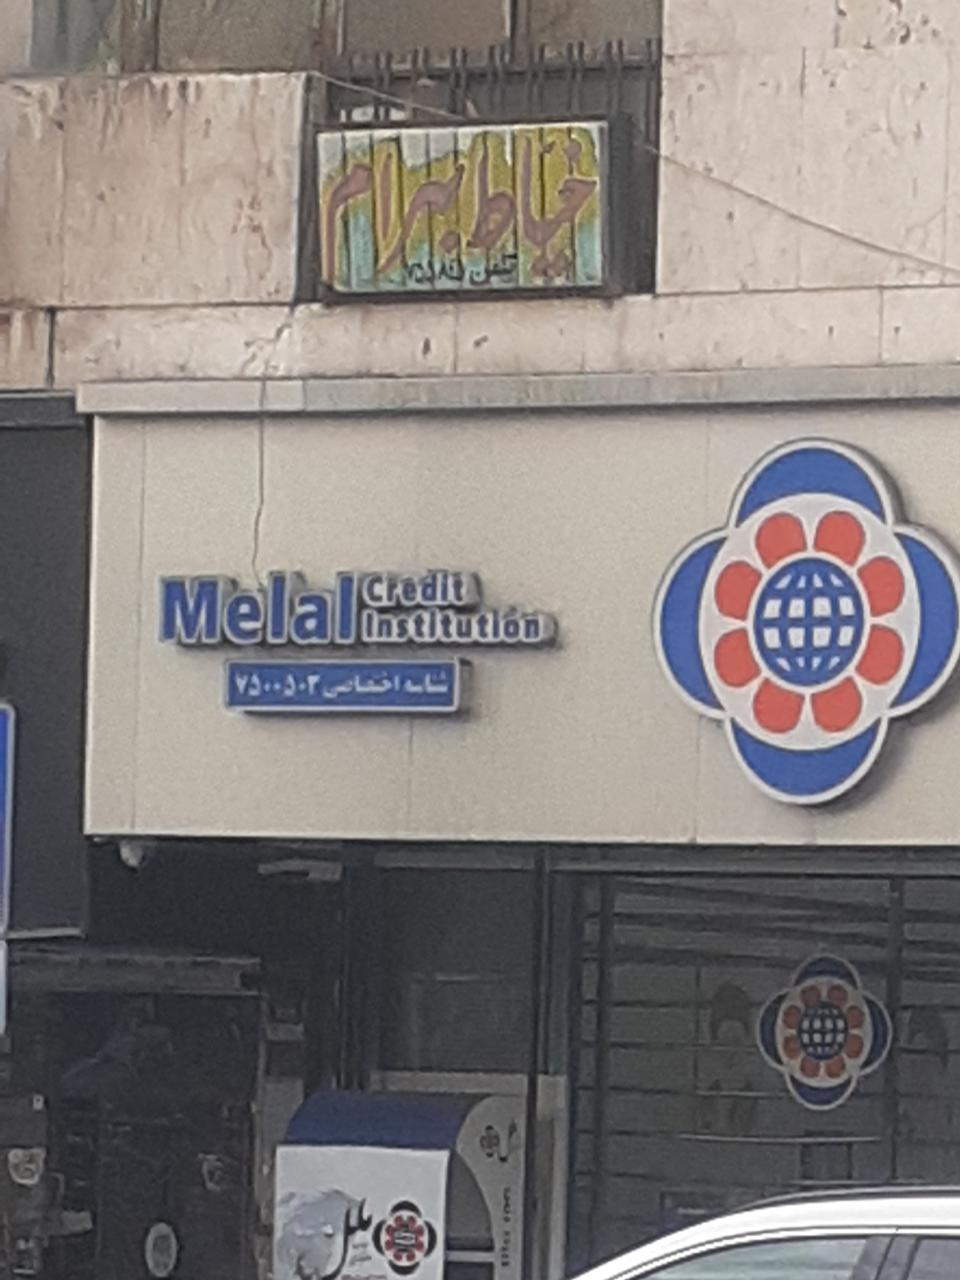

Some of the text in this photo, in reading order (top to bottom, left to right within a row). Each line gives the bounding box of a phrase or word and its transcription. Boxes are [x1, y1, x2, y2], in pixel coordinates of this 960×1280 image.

[363, 572, 467, 608] Credit
[159, 571, 357, 646] Melal
[362, 609, 543, 644] Institution
